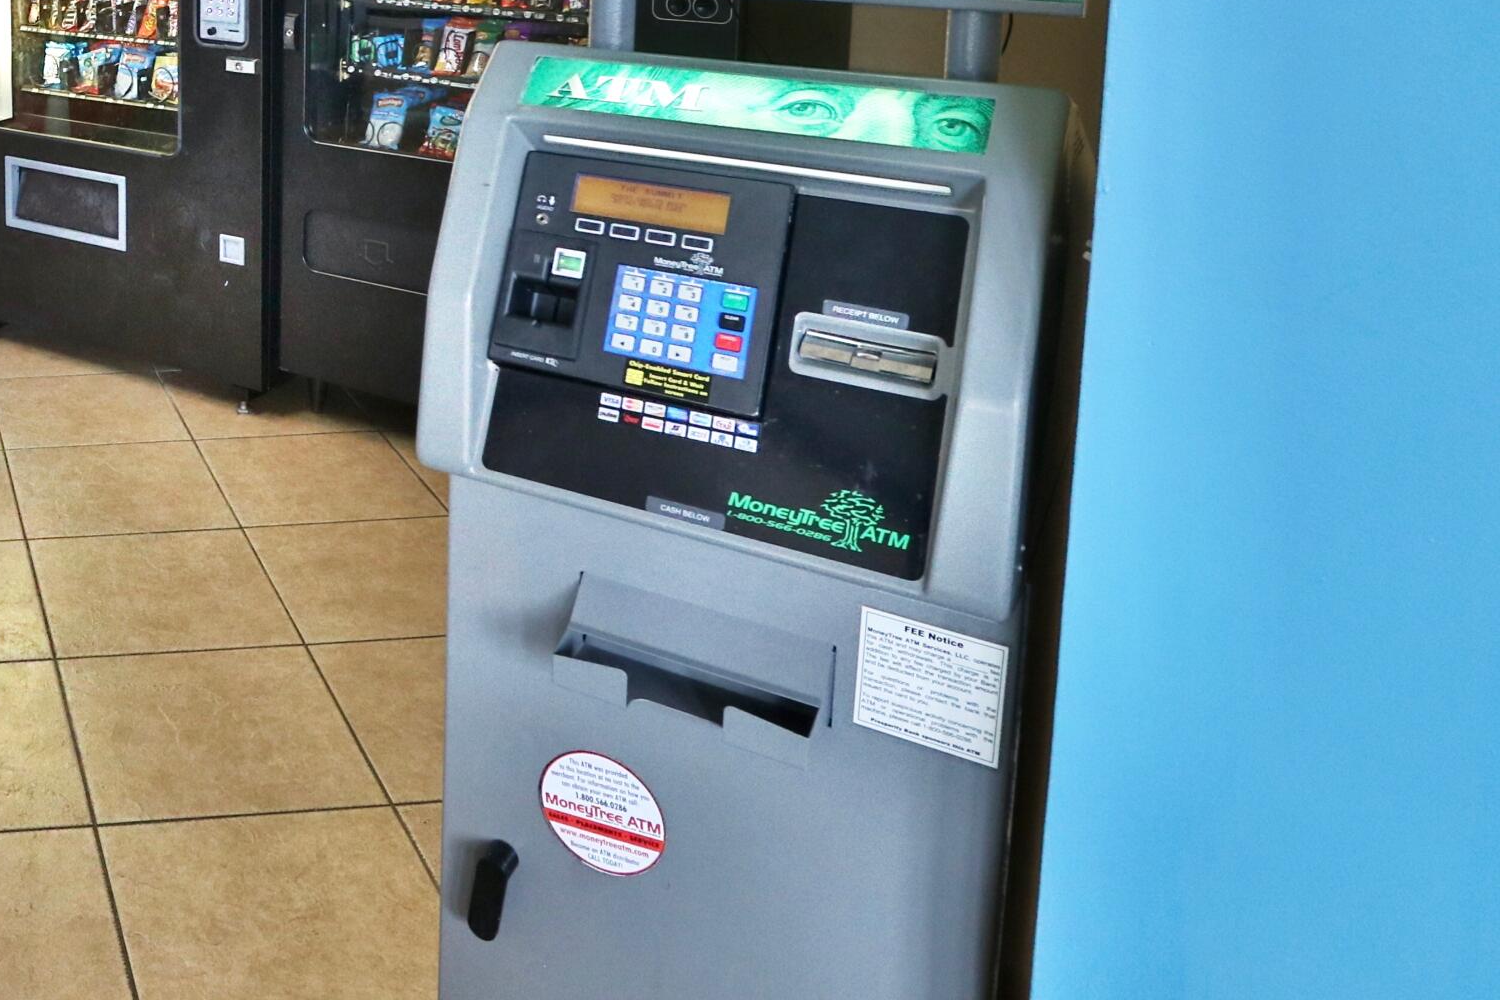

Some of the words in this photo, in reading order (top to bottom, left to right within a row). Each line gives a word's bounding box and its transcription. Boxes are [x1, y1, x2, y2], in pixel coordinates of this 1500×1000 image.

[547, 73, 708, 111] ATM
[654, 256, 699, 270] MoneyTree
[703, 265, 724, 275] ATM
[832, 305, 868, 318] RECEIPT
[868, 312, 900, 324] BELOW
[693, 373, 710, 382] Card
[660, 504, 682, 515] CASH
[682, 510, 710, 522] BELOW
[727, 491, 846, 534] MoneyTree
[860, 525, 911, 550] ATM
[726, 510, 832, 542] 1-800-566-0286
[904, 625, 924, 637] FEE
[928, 631, 964, 648] Notice
[905, 638, 920, 646] ATM
[545, 792, 624, 825] MoneyTree
[627, 816, 661, 835] ATM
